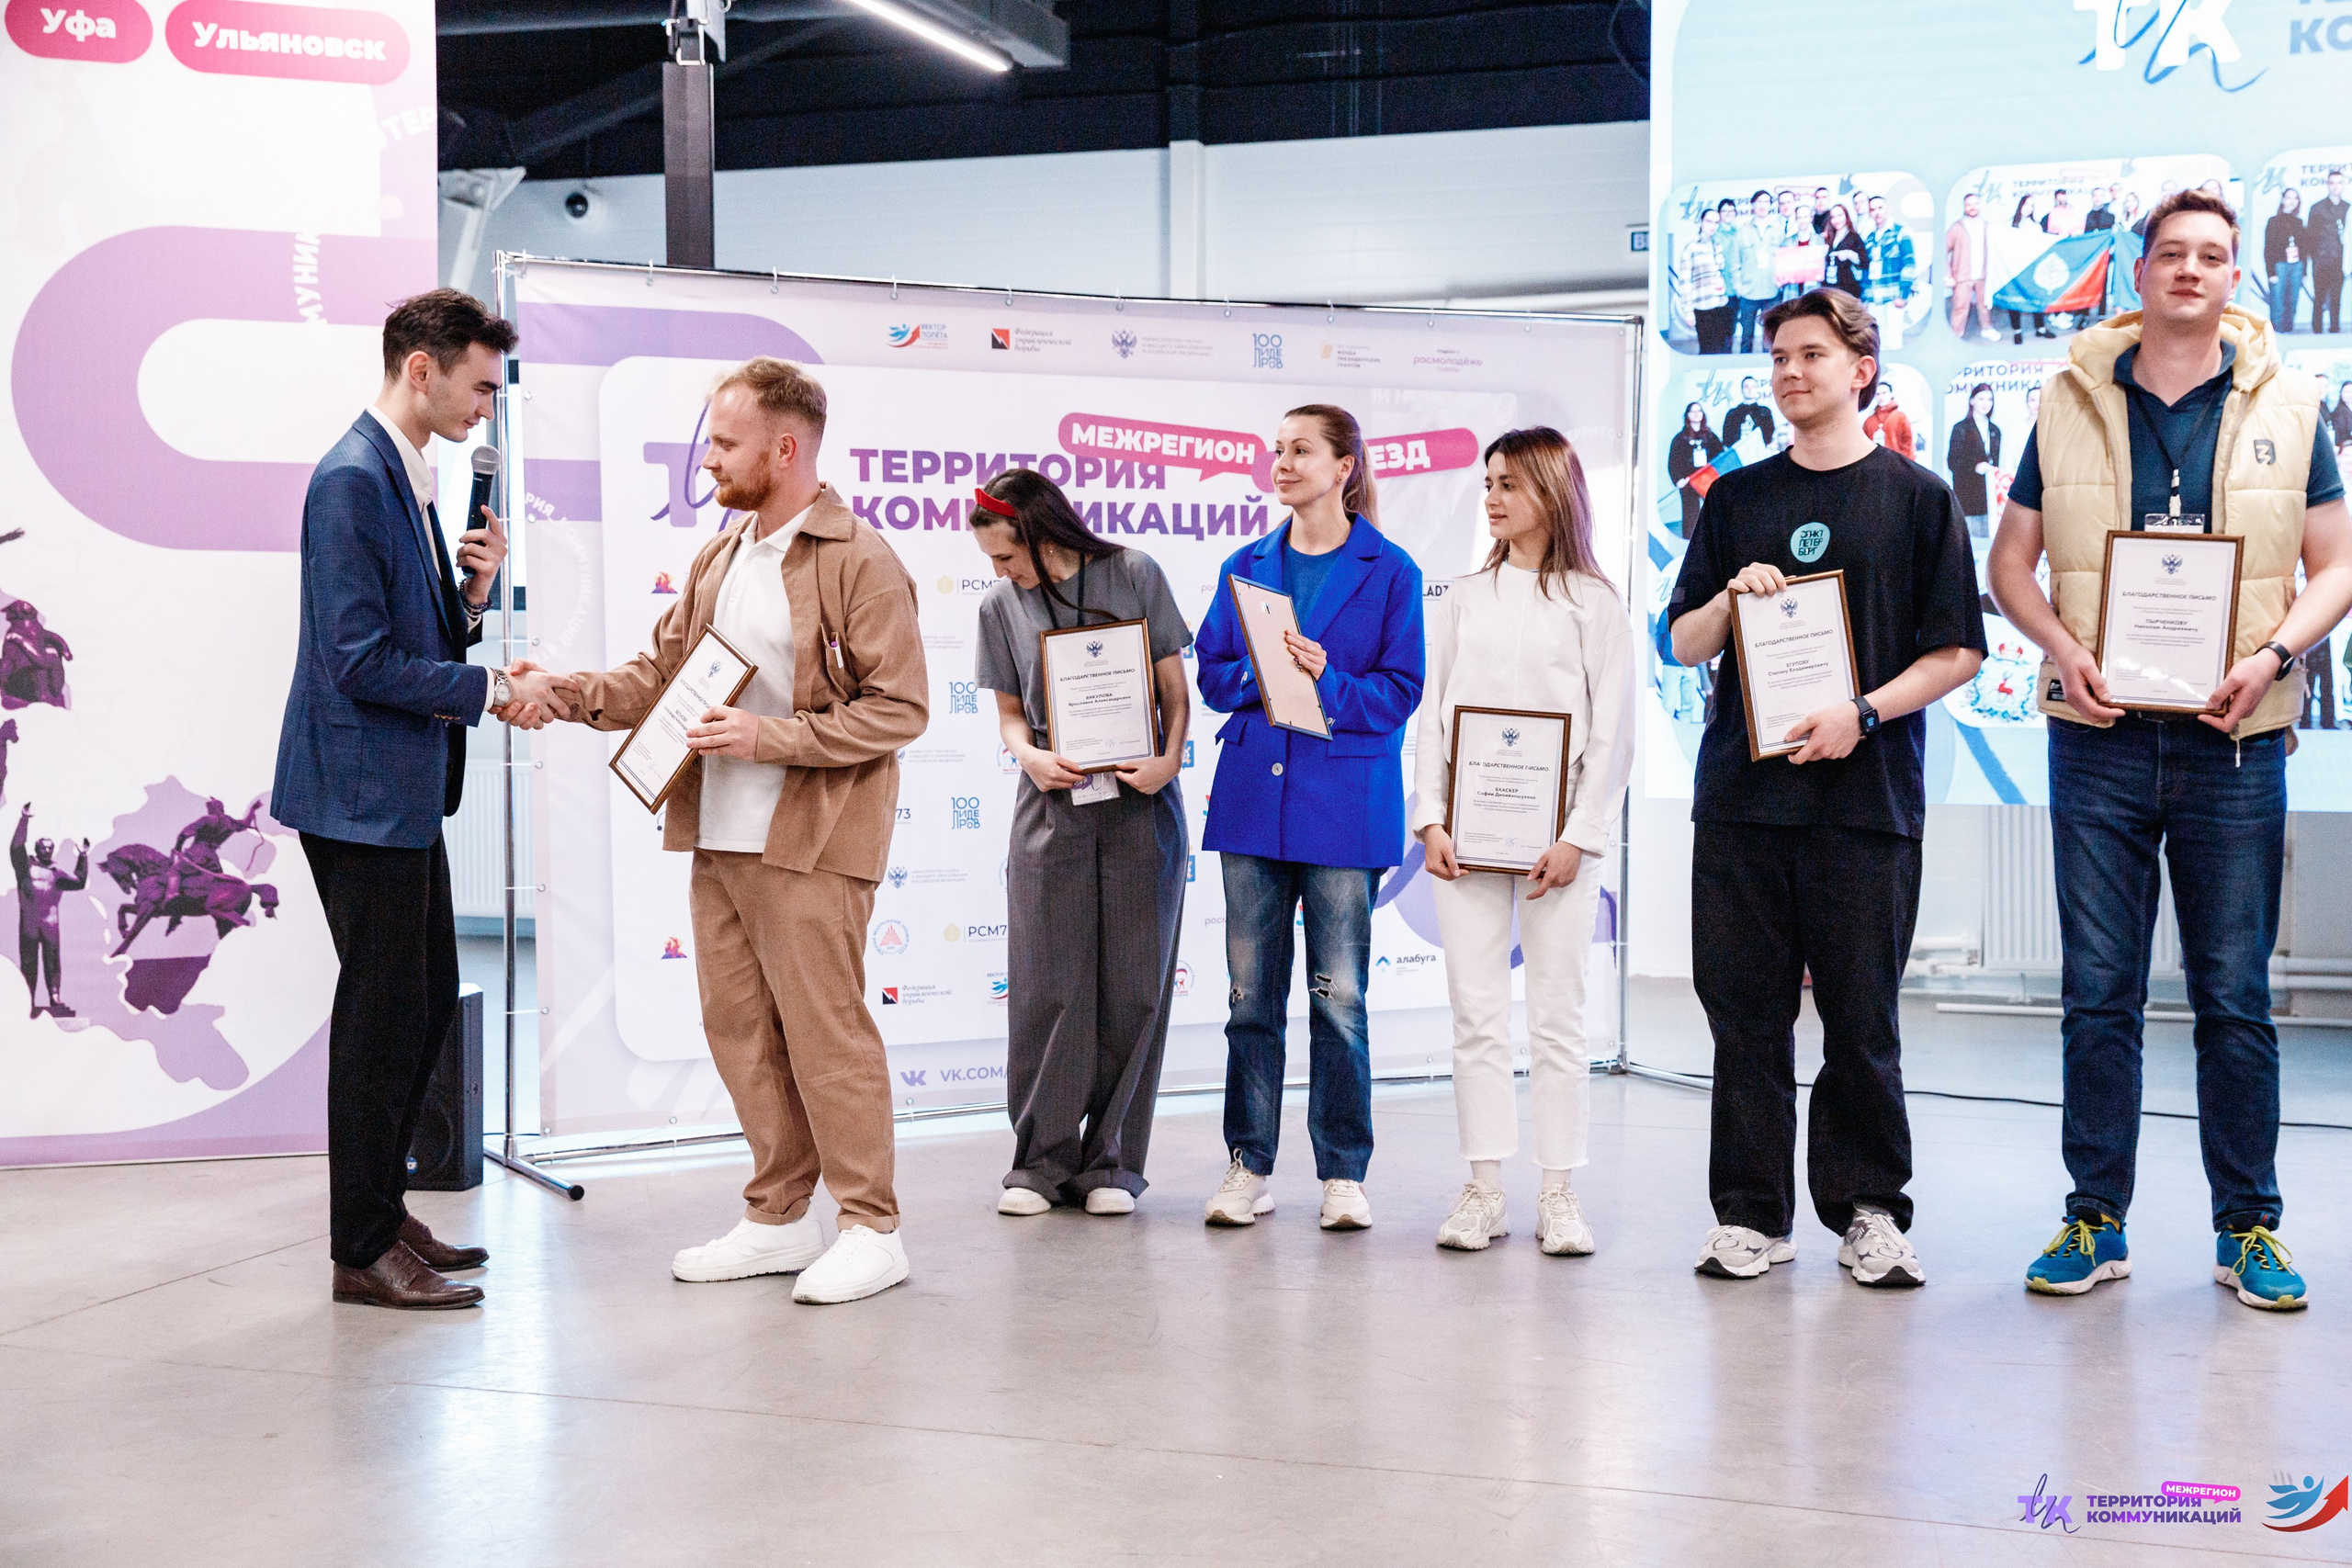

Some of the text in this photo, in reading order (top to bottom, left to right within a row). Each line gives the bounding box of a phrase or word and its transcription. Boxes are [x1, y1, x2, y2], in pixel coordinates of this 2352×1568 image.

[41, 7, 117, 42] Уфа
[192, 21, 387, 62] Ульяновск
[1252, 333, 1283, 347] 100
[1071, 423, 1256, 465] МЕЖРЕГИОН
[1368, 439, 1431, 470] ЕЗД
[850, 448, 1166, 491] ТЕРРИТОРИЯ
[852, 495, 1269, 540] КОМИКАЦИЙ
[1755, 628, 1834, 649] БЛАГОДАРСТВЕННОЕ ПИСЬМО
[1059, 668, 1136, 682] БЛАГОДАРСТВЕННОЕ ПИСЬМО
[949, 682, 978, 694] 100
[951, 796, 980, 809] 100
[968, 924, 1007, 937] РСМ7
[1396, 953, 1437, 965] алабуга
